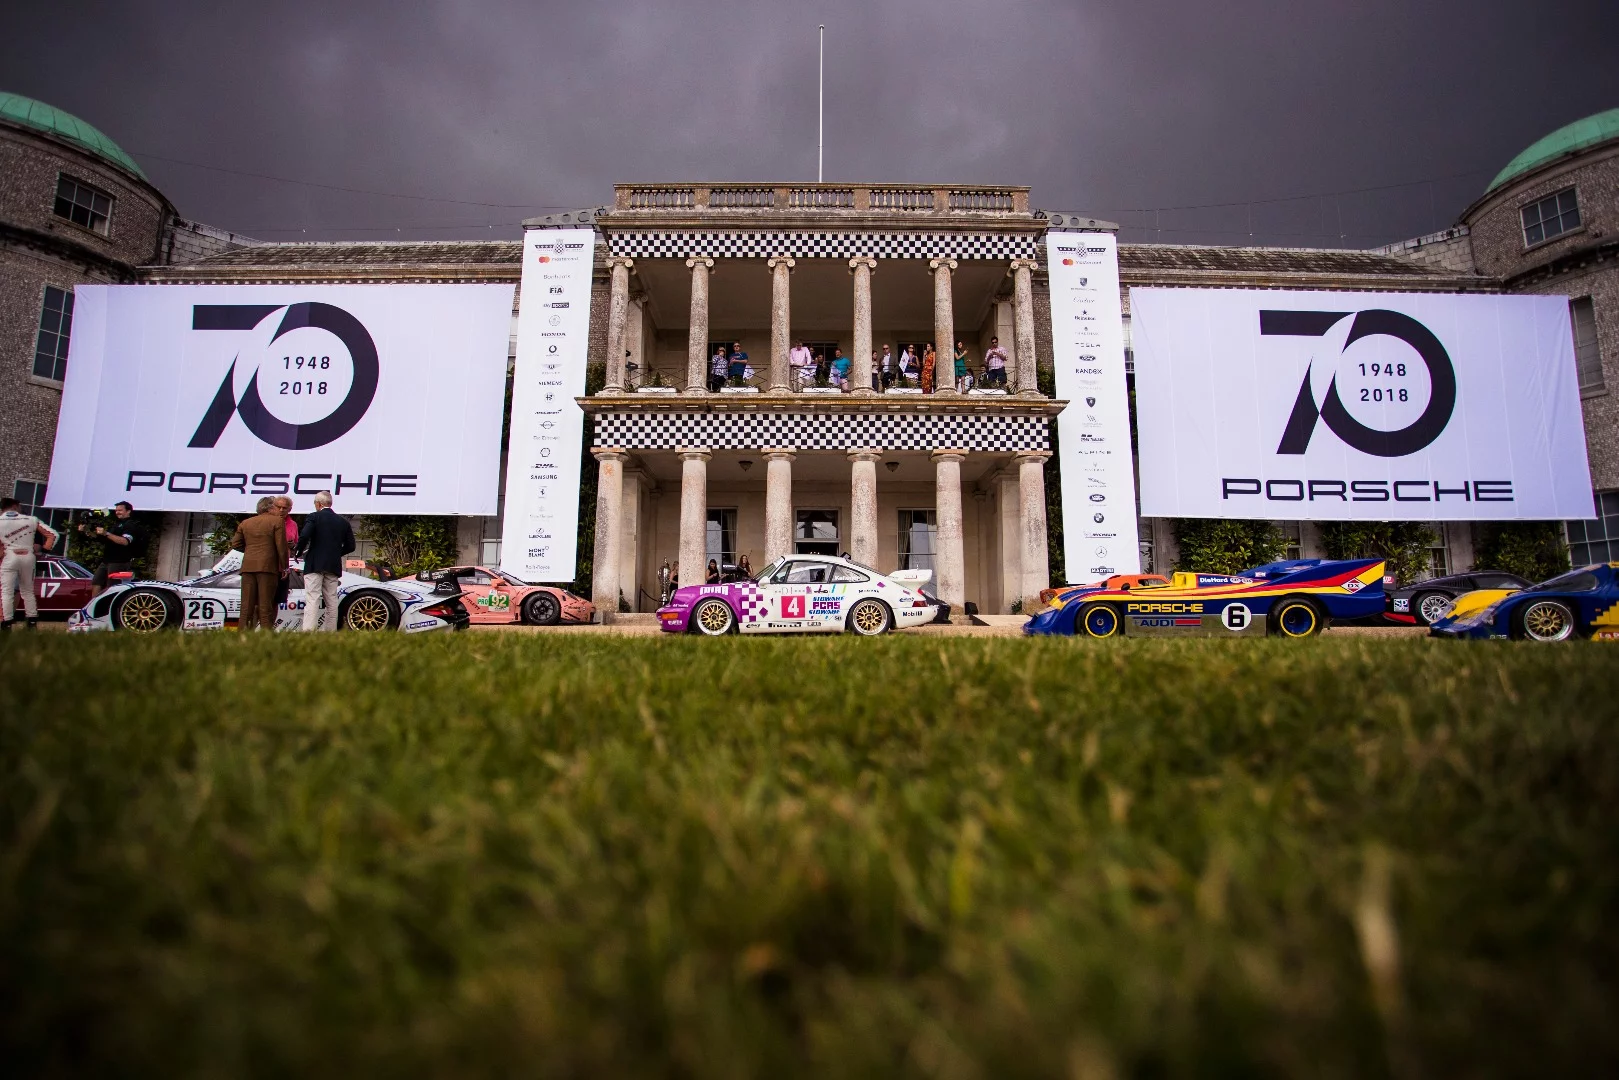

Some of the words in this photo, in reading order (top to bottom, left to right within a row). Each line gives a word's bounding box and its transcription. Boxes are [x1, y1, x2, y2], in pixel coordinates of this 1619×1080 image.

[283, 356, 330, 370] 1948
[1358, 363, 1407, 377] 1948
[187, 302, 379, 450] 70
[1259, 309, 1456, 457] 70
[279, 382, 328, 396] 2018
[1360, 389, 1409, 403] 2018
[126, 471, 417, 496] PORSCHE
[1222, 478, 1514, 502] PORSCHE
[40, 582, 61, 598] 17
[478, 598, 489, 606] PRO
[491, 595, 507, 606] 92
[787, 597, 800, 616] 4
[1127, 603, 1203, 613] PORSCHE
[188, 601, 215, 619] 26
[1228, 605, 1244, 627] 6
[1139, 619, 1174, 627] AUDI
